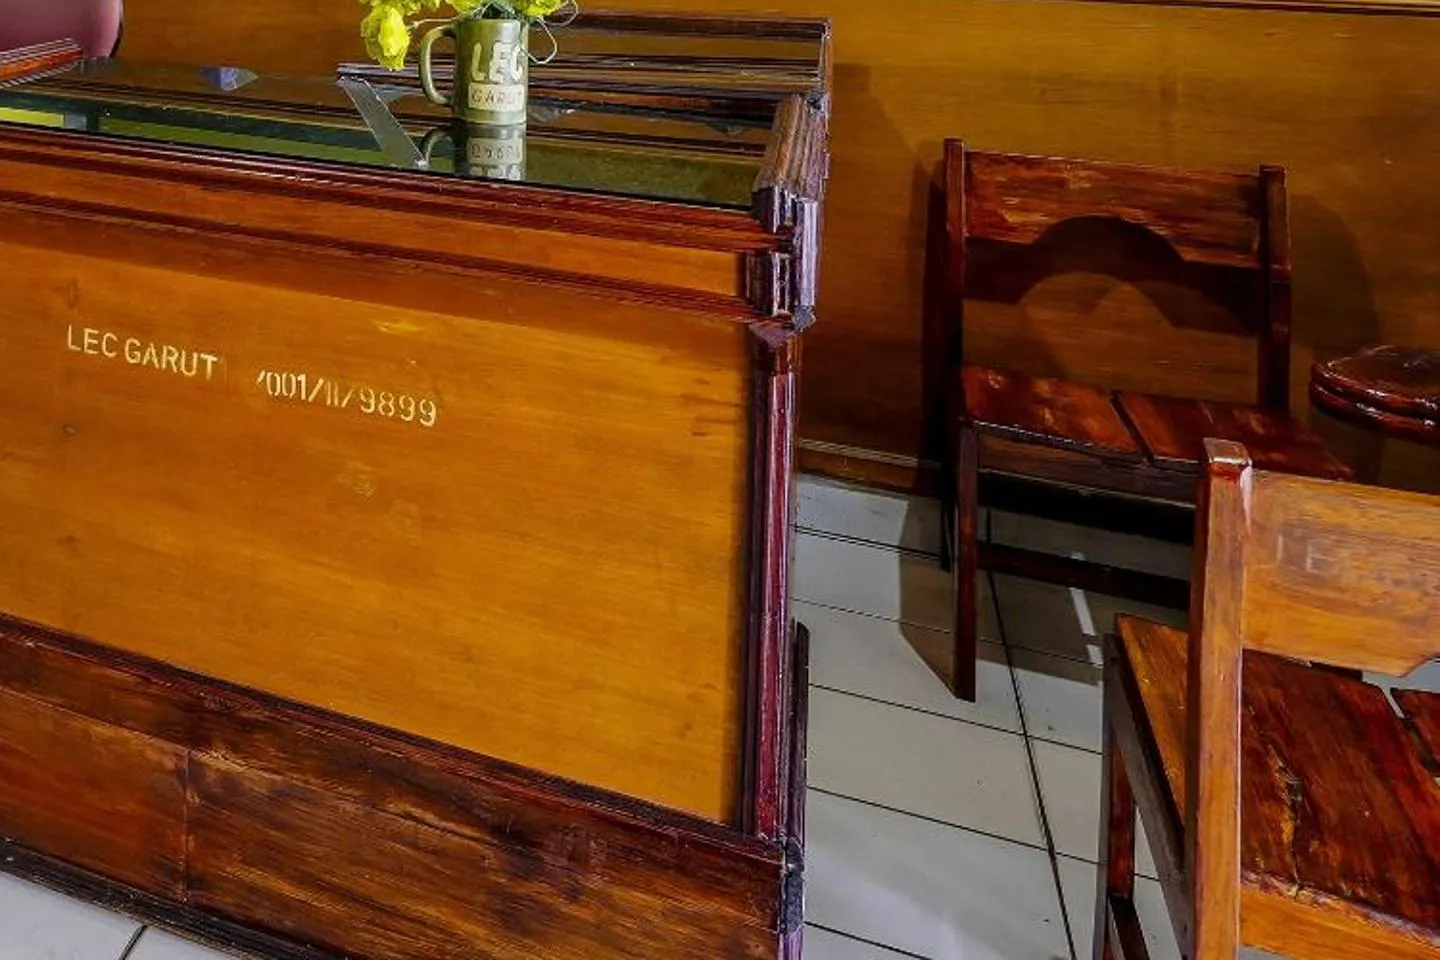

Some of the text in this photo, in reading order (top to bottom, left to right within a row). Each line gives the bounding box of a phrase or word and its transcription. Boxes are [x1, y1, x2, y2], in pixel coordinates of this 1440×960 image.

[471, 42, 523, 82] LEC
[67, 324, 118, 359] LEC
[124, 339, 219, 381] GARUT
